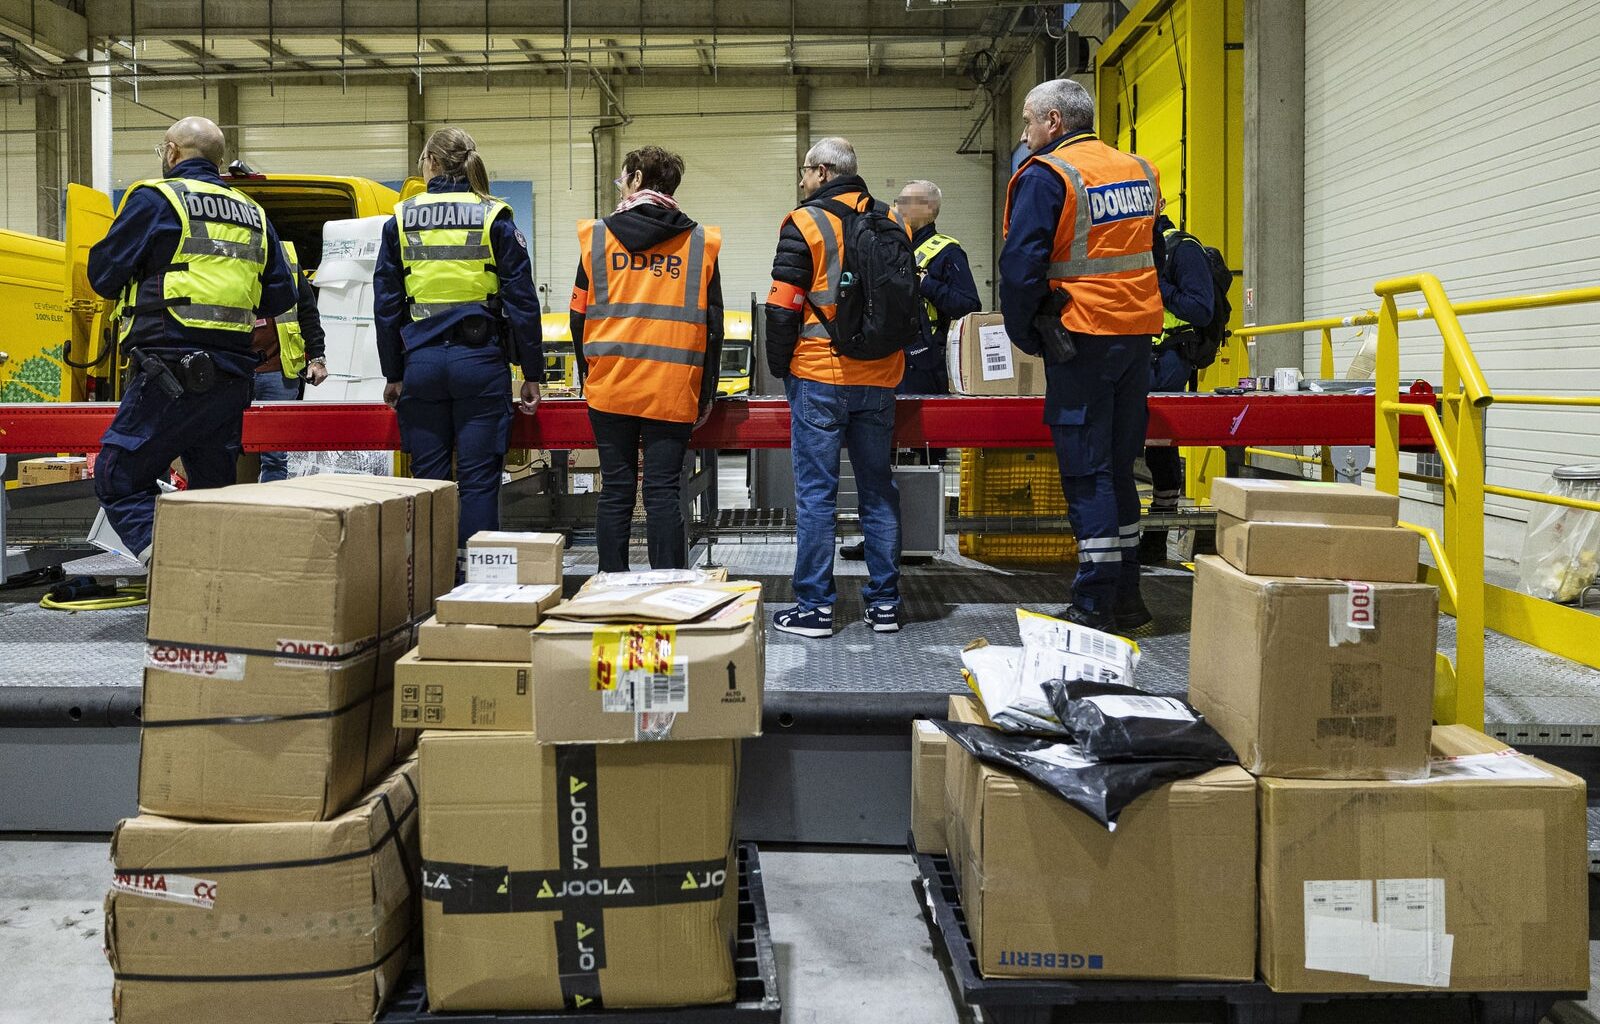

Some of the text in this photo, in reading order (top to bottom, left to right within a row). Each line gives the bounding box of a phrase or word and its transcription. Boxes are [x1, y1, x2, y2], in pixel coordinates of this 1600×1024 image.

[188, 195, 262, 229] DOUANE
[1090, 186, 1154, 220] DOUANES
[405, 205, 482, 228] DOUANE
[611, 252, 682, 273] DDPP
[770, 286, 778, 296] P
[910, 346, 929, 356] DOUA
[469, 554, 518, 565] T1B17L
[153, 645, 228, 664] CONTRA
[276, 640, 341, 657] ONTRA
[404, 687, 413, 700] 16
[726, 690, 741, 698] ALTO
[427, 708, 436, 720] 12
[570, 795, 589, 870] JOOLA
[113, 873, 168, 892] NTRA
[423, 869, 727, 898] LA JOOLA JO
[577, 941, 595, 971] JO
[998, 950, 1086, 969] GEBERIT
